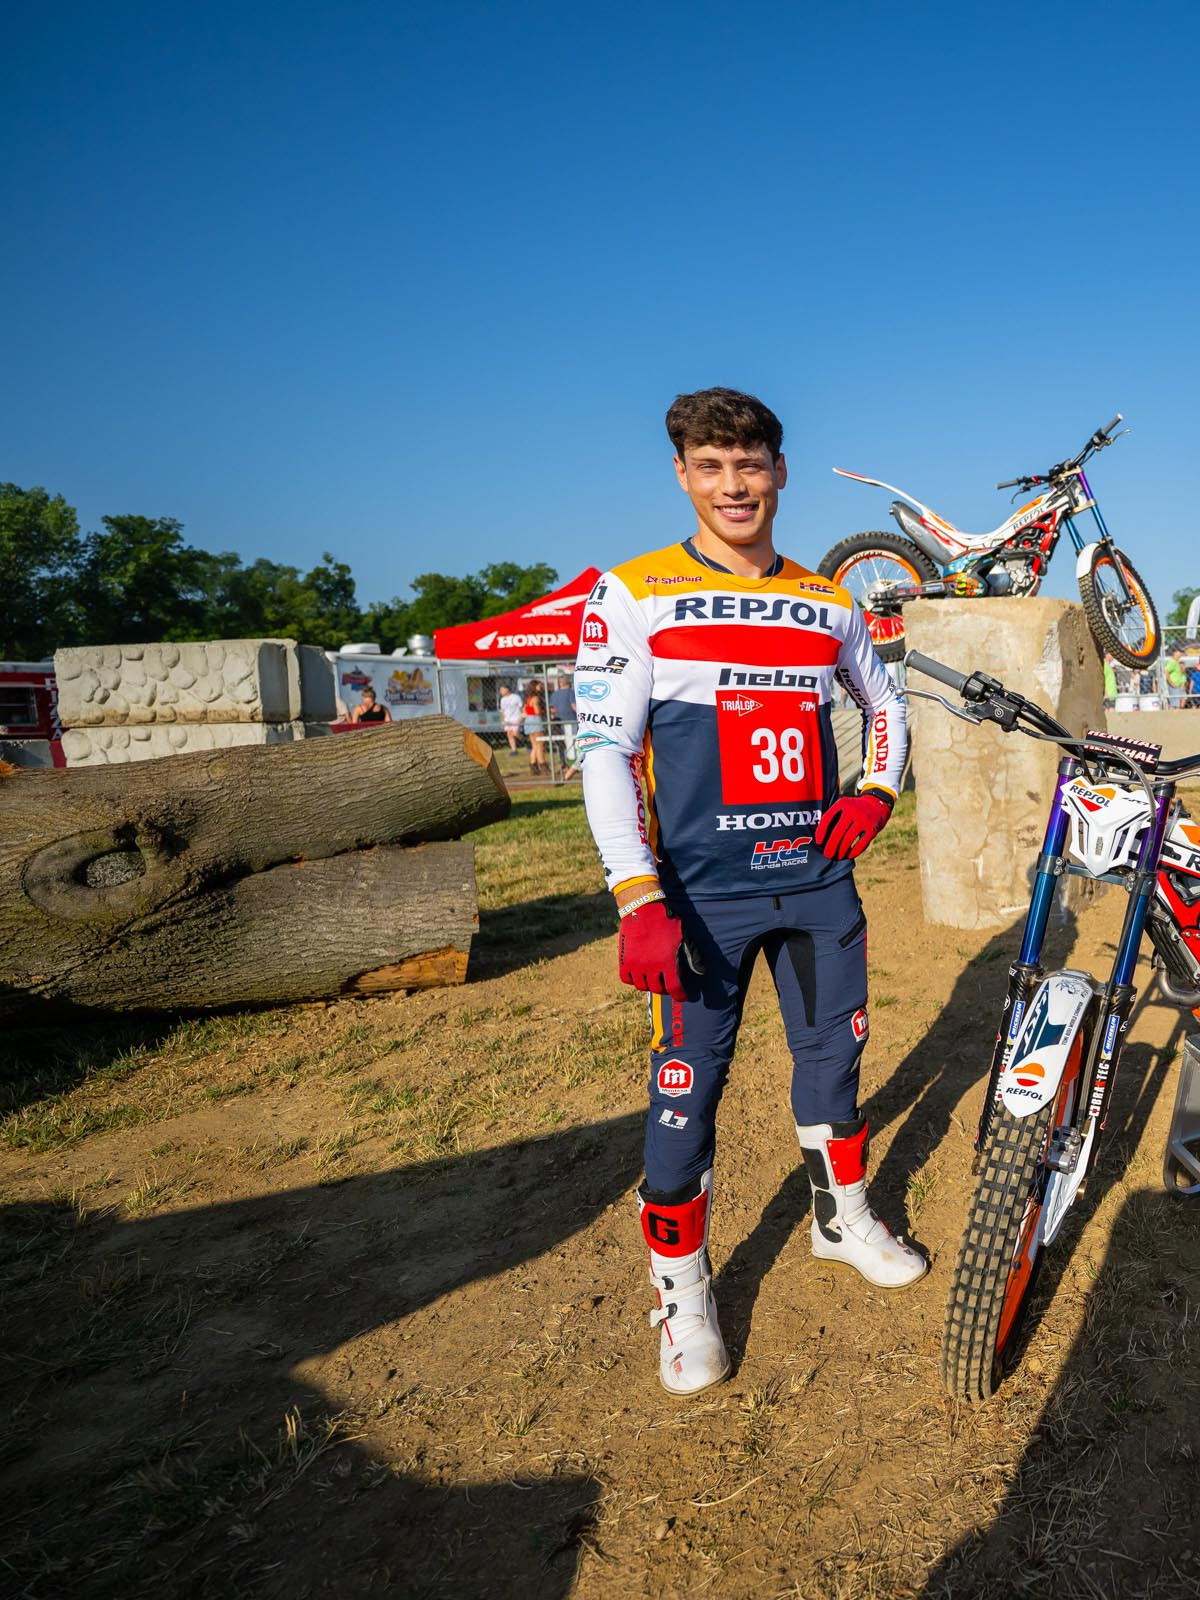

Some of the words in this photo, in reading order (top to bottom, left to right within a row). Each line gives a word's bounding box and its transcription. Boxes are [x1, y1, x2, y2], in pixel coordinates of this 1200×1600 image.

[661, 575, 703, 585] SHOWA
[799, 581, 836, 595] HRC
[674, 595, 834, 631] REPSOL
[497, 634, 572, 649] HONDA
[719, 668, 819, 689] hebo
[721, 700, 756, 712] TRIALGP
[800, 701, 816, 712] FIM
[751, 727, 805, 783] 38
[1069, 785, 1111, 808] REPSOL
[751, 836, 813, 866] HRC
[751, 863, 781, 871] Honda
[781, 858, 808, 868] RACING
[1012, 1002, 1023, 1035] MICHELIN
[1105, 1016, 1117, 1049] MICHELIN
[1006, 1087, 1044, 1101] REPSOL
[647, 1211, 681, 1245] G
